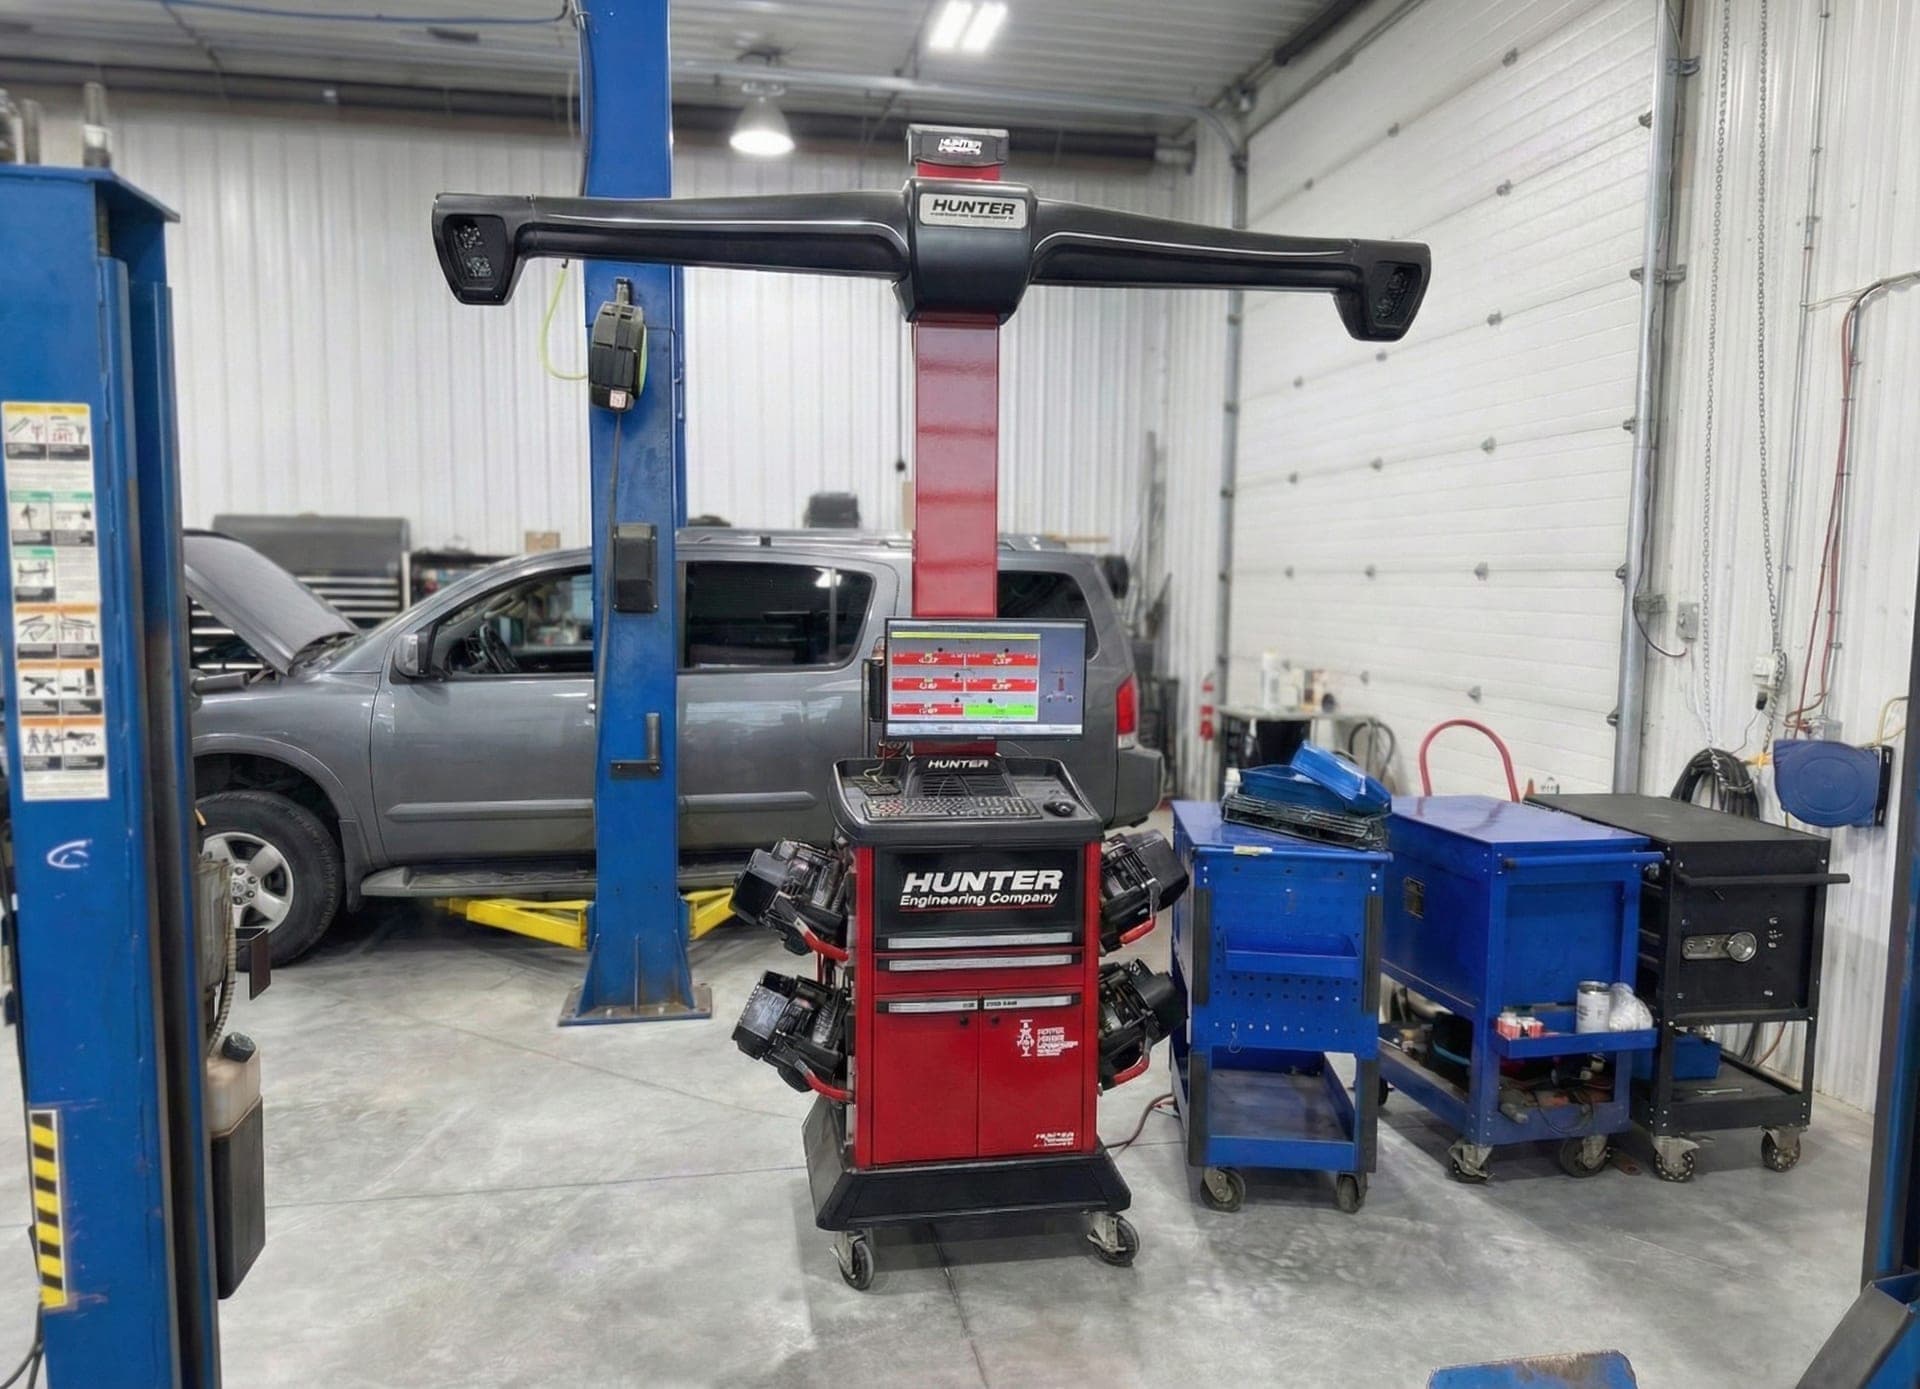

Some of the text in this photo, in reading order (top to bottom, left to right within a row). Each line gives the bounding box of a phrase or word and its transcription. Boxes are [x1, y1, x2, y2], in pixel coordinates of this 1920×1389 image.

[932, 198, 1016, 215] HUNTER
[928, 759, 989, 769] HUNTER
[903, 869, 1064, 893] HUNTER
[900, 892, 1058, 907] Engineering Company
